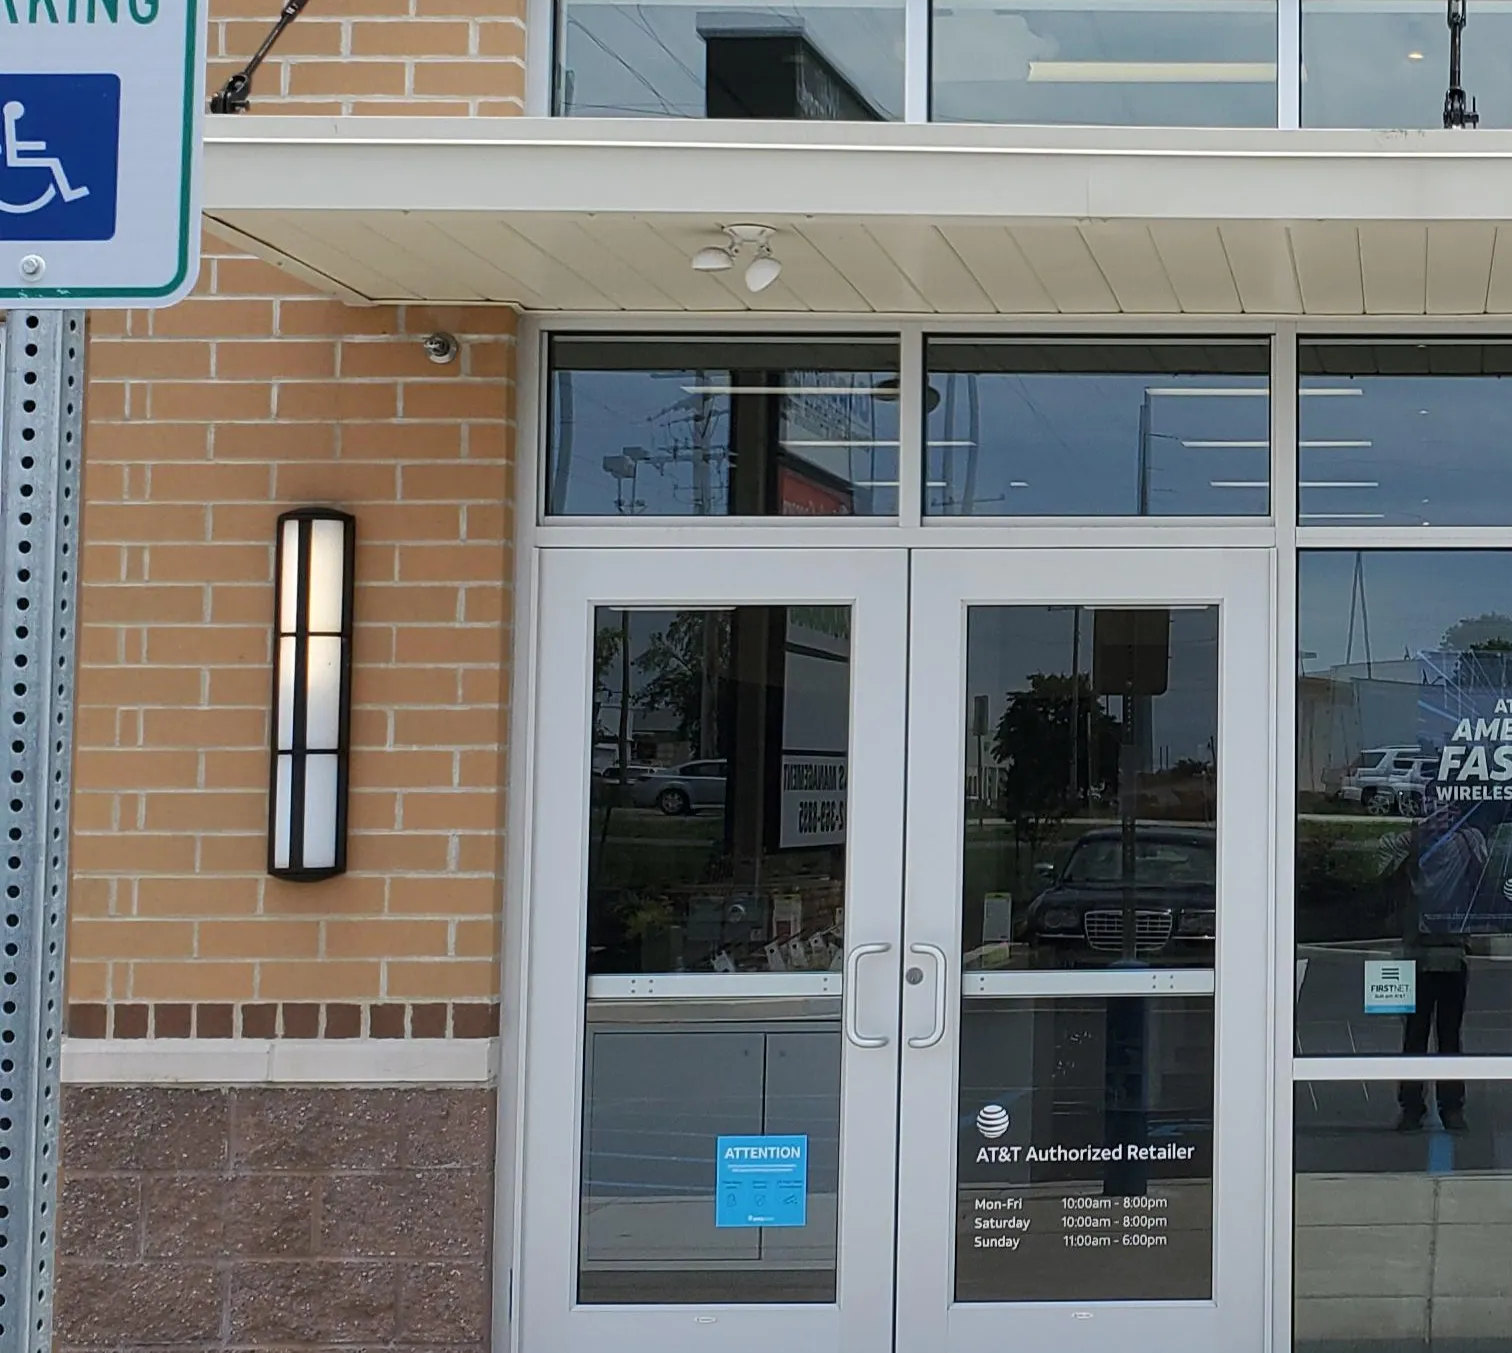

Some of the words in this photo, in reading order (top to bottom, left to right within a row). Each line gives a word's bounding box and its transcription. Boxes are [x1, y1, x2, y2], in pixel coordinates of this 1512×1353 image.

[724, 1146, 801, 1160] ATTENTION
[975, 1146, 1022, 1163] AT&T
[1025, 1144, 1123, 1163] Authorized
[1127, 1143, 1196, 1161] Retailer
[974, 1197, 1023, 1211] Mon-Fri
[1061, 1197, 1112, 1210] 10:00am
[1122, 1197, 1168, 1212] 8:00pm
[974, 1216, 1031, 1231] Saturday
[1061, 1216, 1112, 1228] 10:00am
[1122, 1216, 1168, 1230] 8:00pm
[974, 1235, 1021, 1250] Sunday
[1062, 1235, 1111, 1247] 11:00am
[1121, 1235, 1168, 1249] 6:00pm
